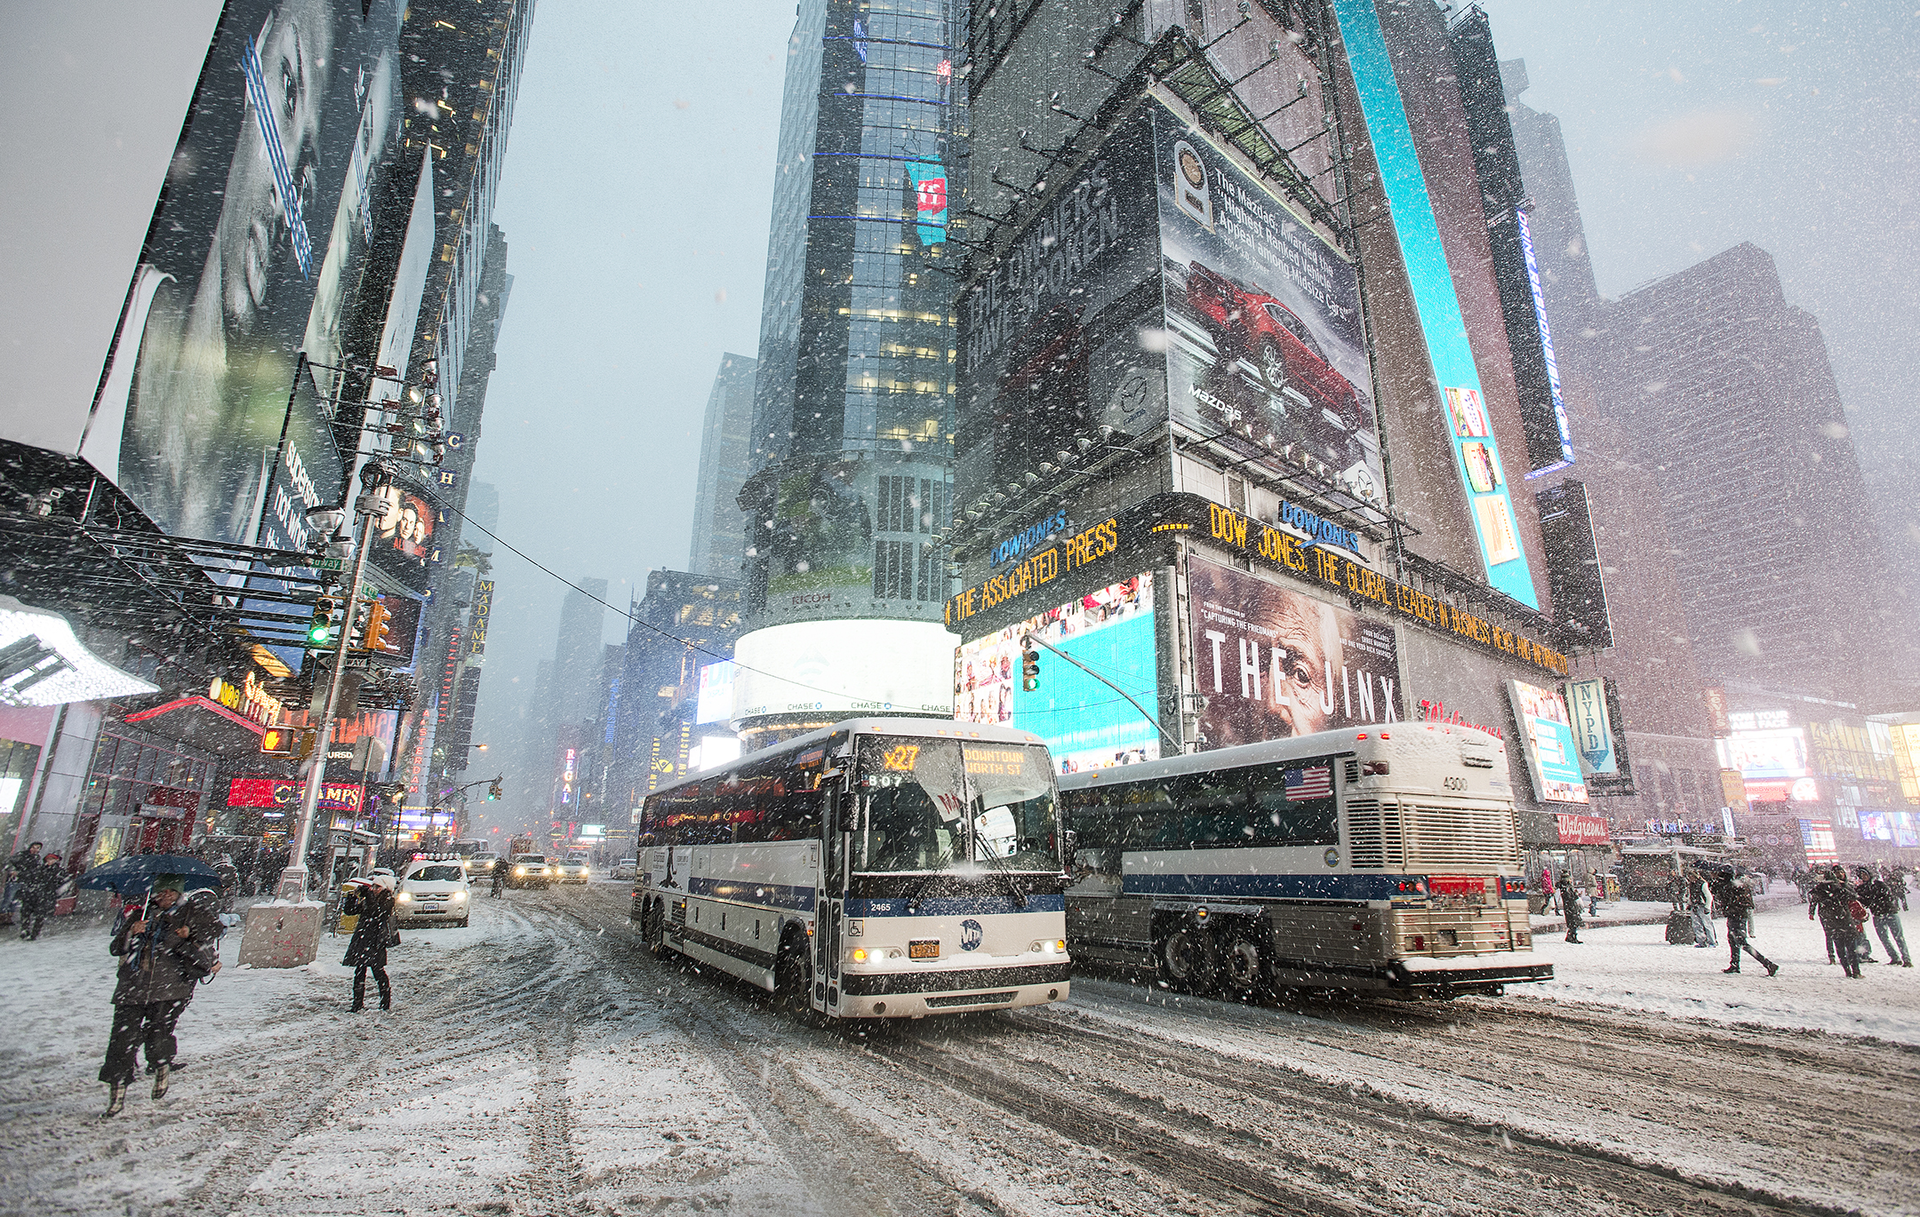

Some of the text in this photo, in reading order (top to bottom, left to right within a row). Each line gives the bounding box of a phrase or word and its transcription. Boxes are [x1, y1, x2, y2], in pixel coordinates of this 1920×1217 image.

[1009, 163, 1108, 292] OWNERS
[1214, 166, 1235, 197] The
[1319, 254, 1334, 278] the
[1517, 209, 1539, 271] DRINK
[1220, 209, 1255, 250] Appeal
[1257, 241, 1290, 280] among
[1291, 264, 1325, 304] Midsize
[1265, 227, 1300, 268] Ranked
[1300, 256, 1332, 293] Vehicle
[273, 484, 293, 528] not
[955, 588, 977, 621] THE
[1066, 517, 1118, 571] PRESS
[1210, 502, 1248, 548] DOW
[1314, 547, 1341, 586] THE
[1346, 562, 1392, 606] GLOBAL
[1396, 583, 1436, 623] LEADER
[1438, 602, 1449, 629] IN
[1451, 606, 1491, 645] BUSINESS
[1492, 624, 1514, 654] NEWS
[1517, 634, 1531, 661] AND
[791, 593, 831, 606] RICOH
[471, 580, 493, 654] MADAME
[1201, 608, 1235, 627] "CAPTURING
[1236, 619, 1247, 630] THE
[1205, 628, 1398, 724] THE JINX
[744, 706, 761, 716] CHASE
[787, 702, 814, 711] CHASE
[850, 701, 882, 711] CHASE
[920, 703, 951, 713] CHASE
[1579, 684, 1600, 751] NYPD
[1728, 710, 1790, 722] HOW YOUR
[679, 721, 692, 758] VICTORY
[1758, 718, 1790, 729] FACE
[964, 749, 1024, 763] DOWNTOWN
[965, 762, 1021, 775] WORTH ST
[562, 748, 576, 804] REGAL
[1443, 777, 1468, 791] 4300
[1557, 816, 1607, 843] Walgreens
[871, 903, 891, 912] 2465
